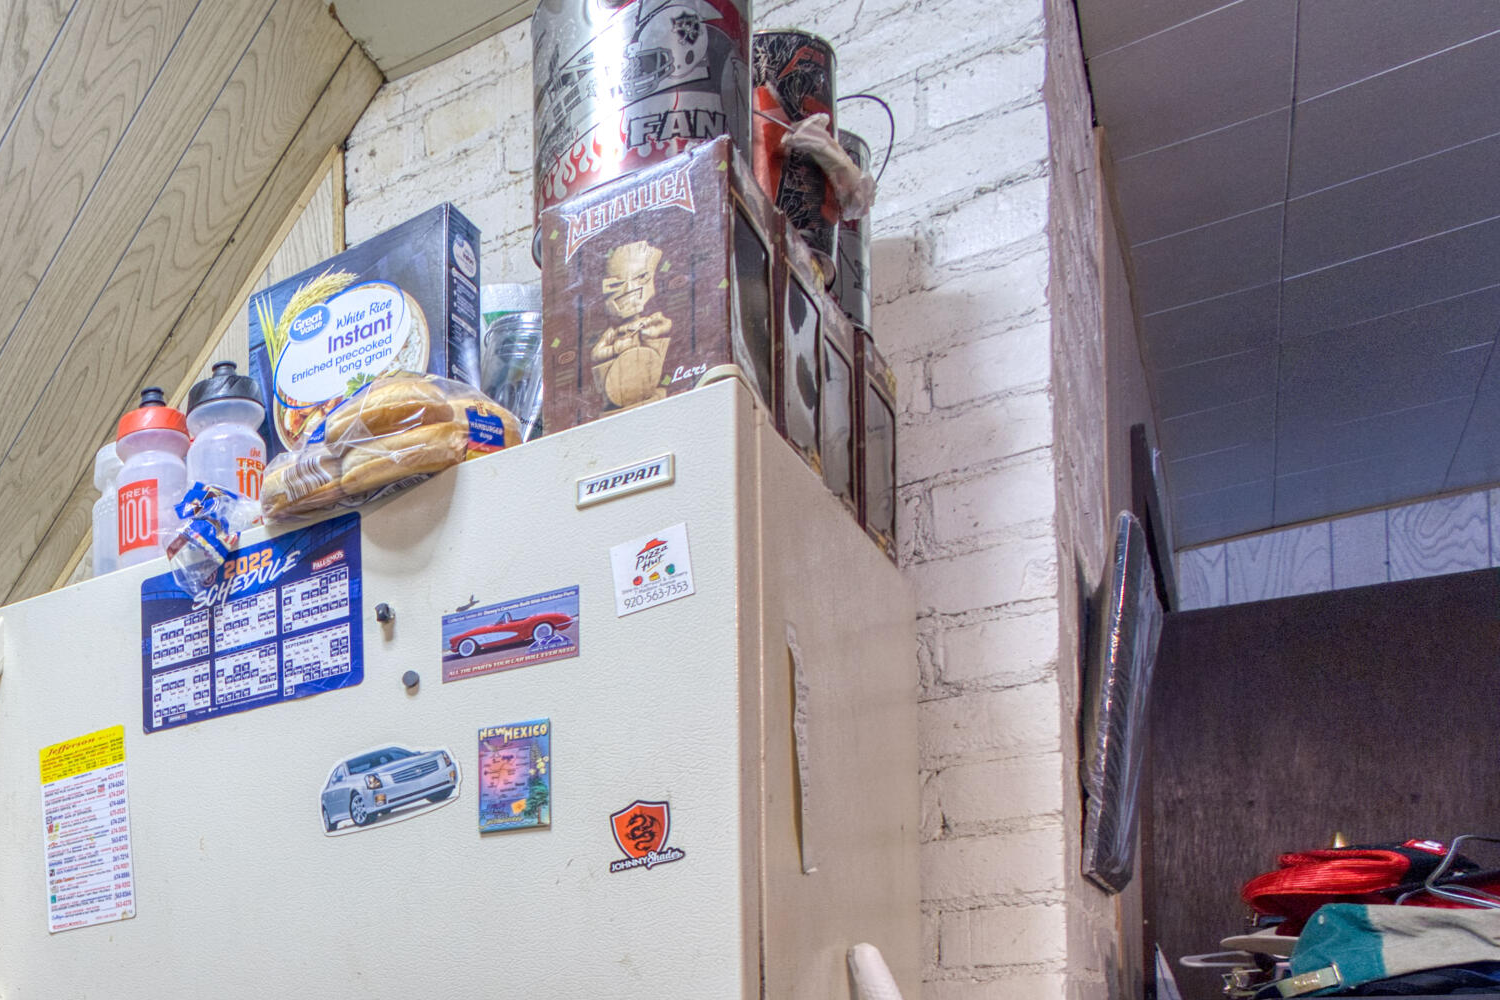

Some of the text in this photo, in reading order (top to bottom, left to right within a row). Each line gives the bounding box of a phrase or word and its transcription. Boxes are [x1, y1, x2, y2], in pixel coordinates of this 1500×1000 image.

[627, 109, 726, 148] FAN
[561, 159, 696, 264] METALLICA
[294, 310, 323, 331] Great
[300, 321, 324, 336] Value
[336, 299, 393, 330] White Rice
[328, 311, 393, 354] Instant
[291, 334, 393, 384] Enriched precooked
[339, 347, 392, 375] long grain
[671, 363, 708, 383] Lars
[120, 486, 150, 501] TREK
[586, 464, 661, 495] TAPPAN
[120, 496, 151, 547] 100
[223, 548, 273, 580] 2022
[636, 545, 668, 570] Pizza
[642, 554, 665, 573] Hut
[192, 550, 301, 611] SCHEDULE
[624, 581, 689, 609] 920-563-7353
[285, 638, 313, 650] SEPTEMBER
[46, 737, 96, 758] Jefferson
[479, 723, 547, 744] NEW MEXICO
[611, 856, 647, 872] JOHNNY
